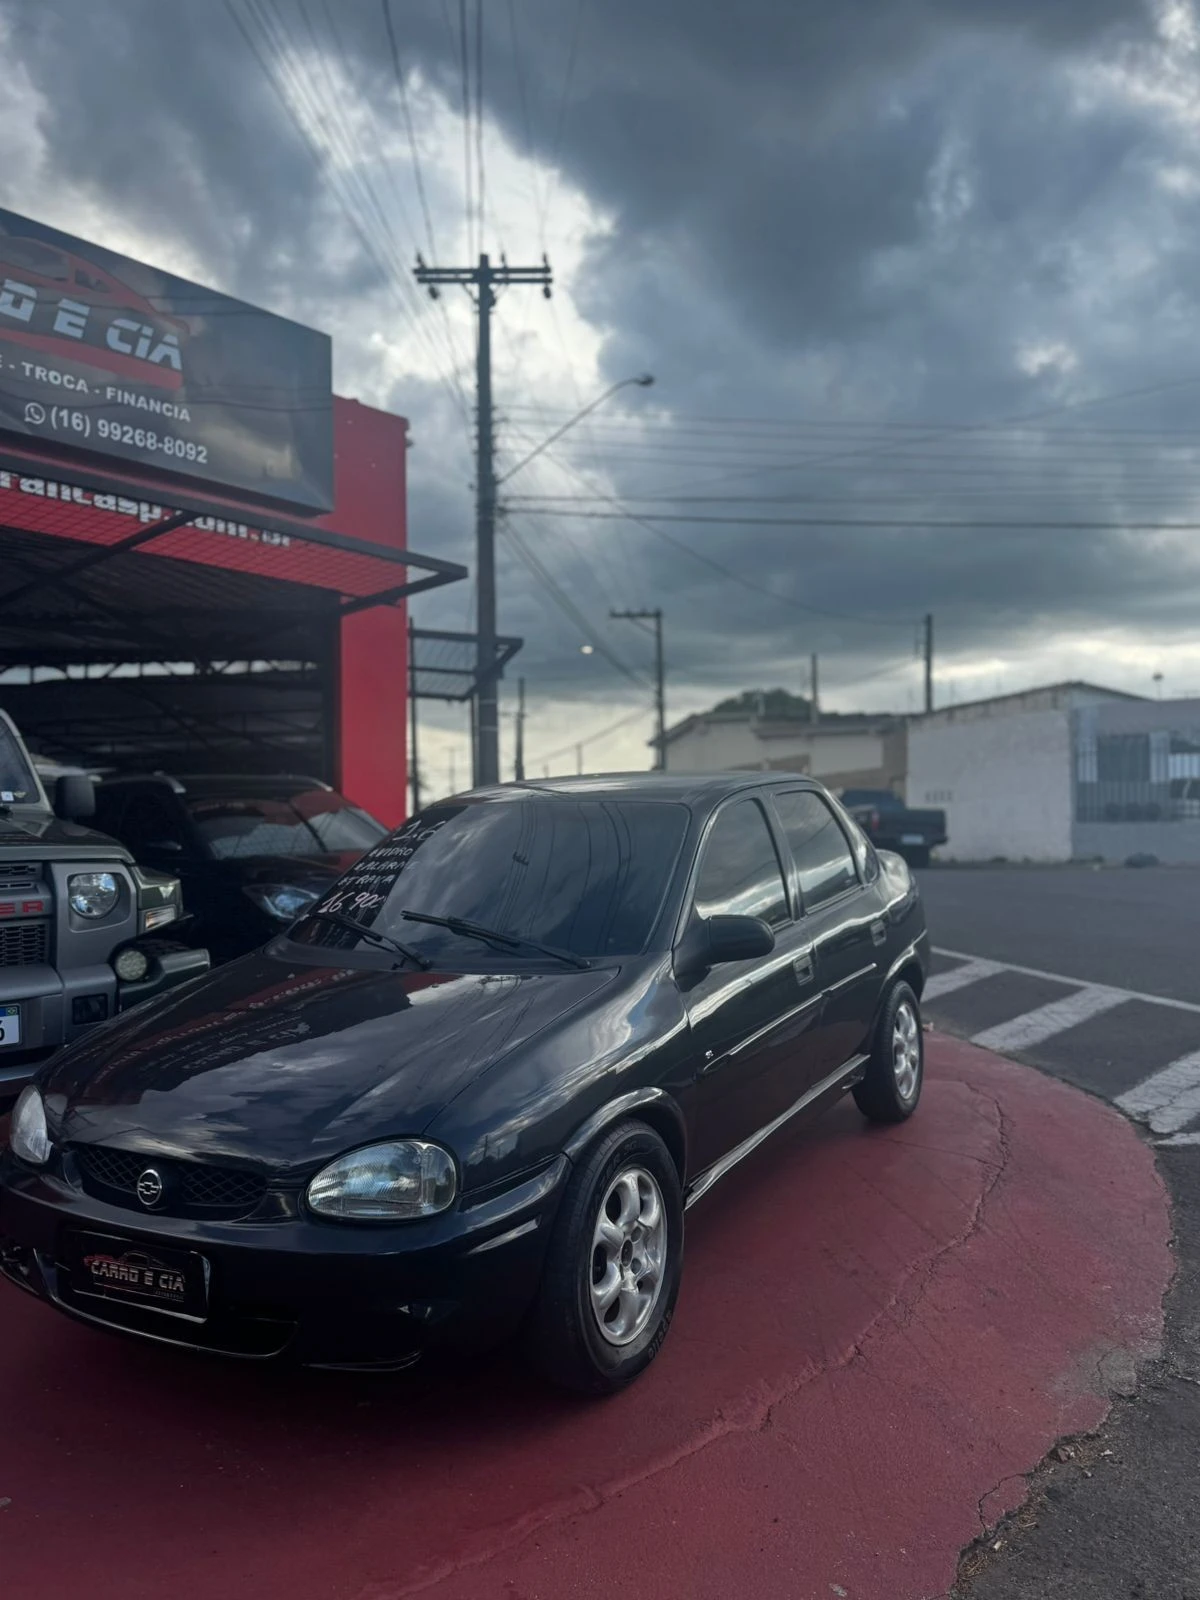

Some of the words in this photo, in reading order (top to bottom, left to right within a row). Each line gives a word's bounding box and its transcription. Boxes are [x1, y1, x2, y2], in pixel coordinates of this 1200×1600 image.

[53, 298, 90, 339] E
[21, 361, 89, 394] TROCA
[106, 386, 191, 423] FINANCIA
[51, 405, 91, 437] (16)
[97, 418, 208, 464] 99268-8092
[392, 819, 446, 842] 1.6
[91, 1259, 138, 1283] CARRO
[143, 1270, 153, 1287] E
